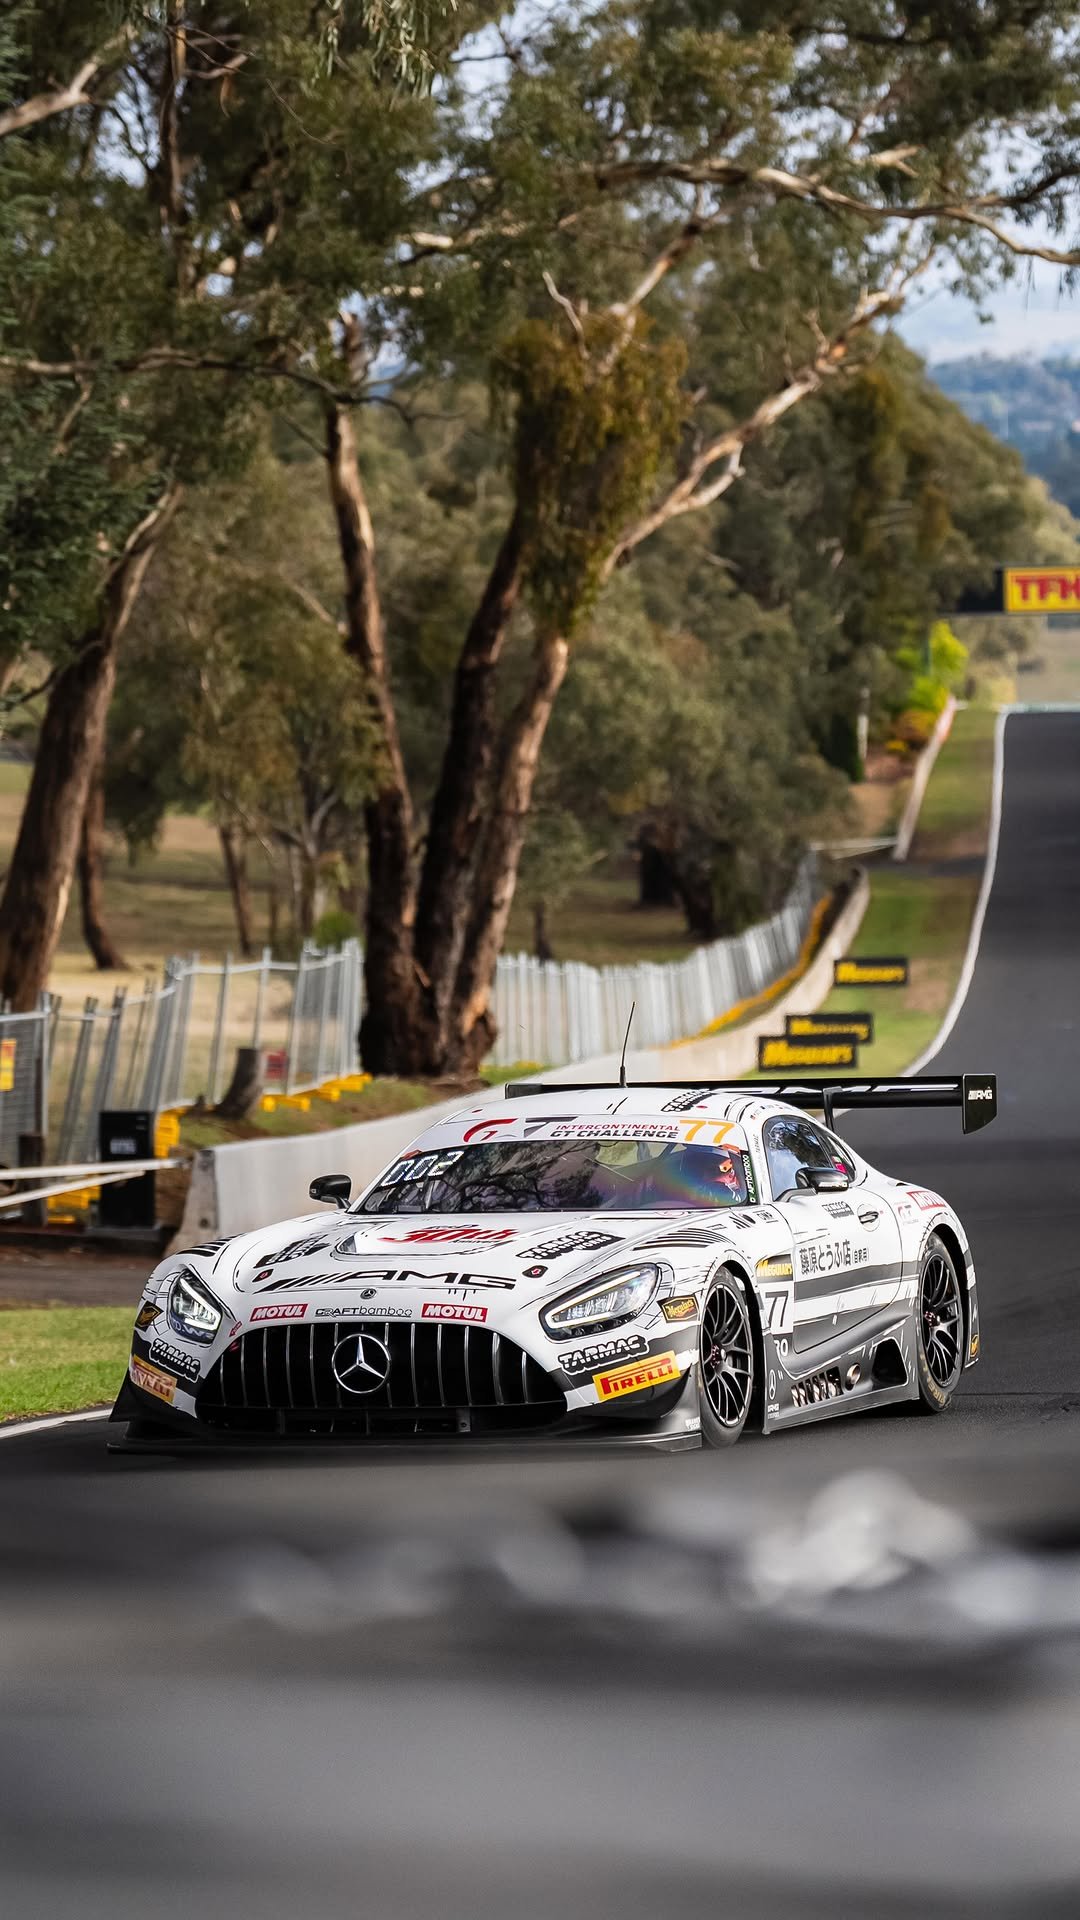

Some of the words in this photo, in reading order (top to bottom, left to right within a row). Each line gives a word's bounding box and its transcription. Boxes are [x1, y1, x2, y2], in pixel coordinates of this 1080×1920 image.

[549, 1130, 573, 1138] GT
[576, 1130, 679, 1139] CHALLENGE
[555, 1124, 680, 1132] INTERCONTINENTAL
[679, 1119, 735, 1143] 77
[333, 1270, 517, 1290] AMG
[252, 1304, 304, 1320] MOTUL
[424, 1304, 486, 1321] MOTUL
[765, 1291, 789, 1328] 77
[559, 1336, 641, 1370] TARMAC
[600, 1358, 674, 1396] PIRELLI
